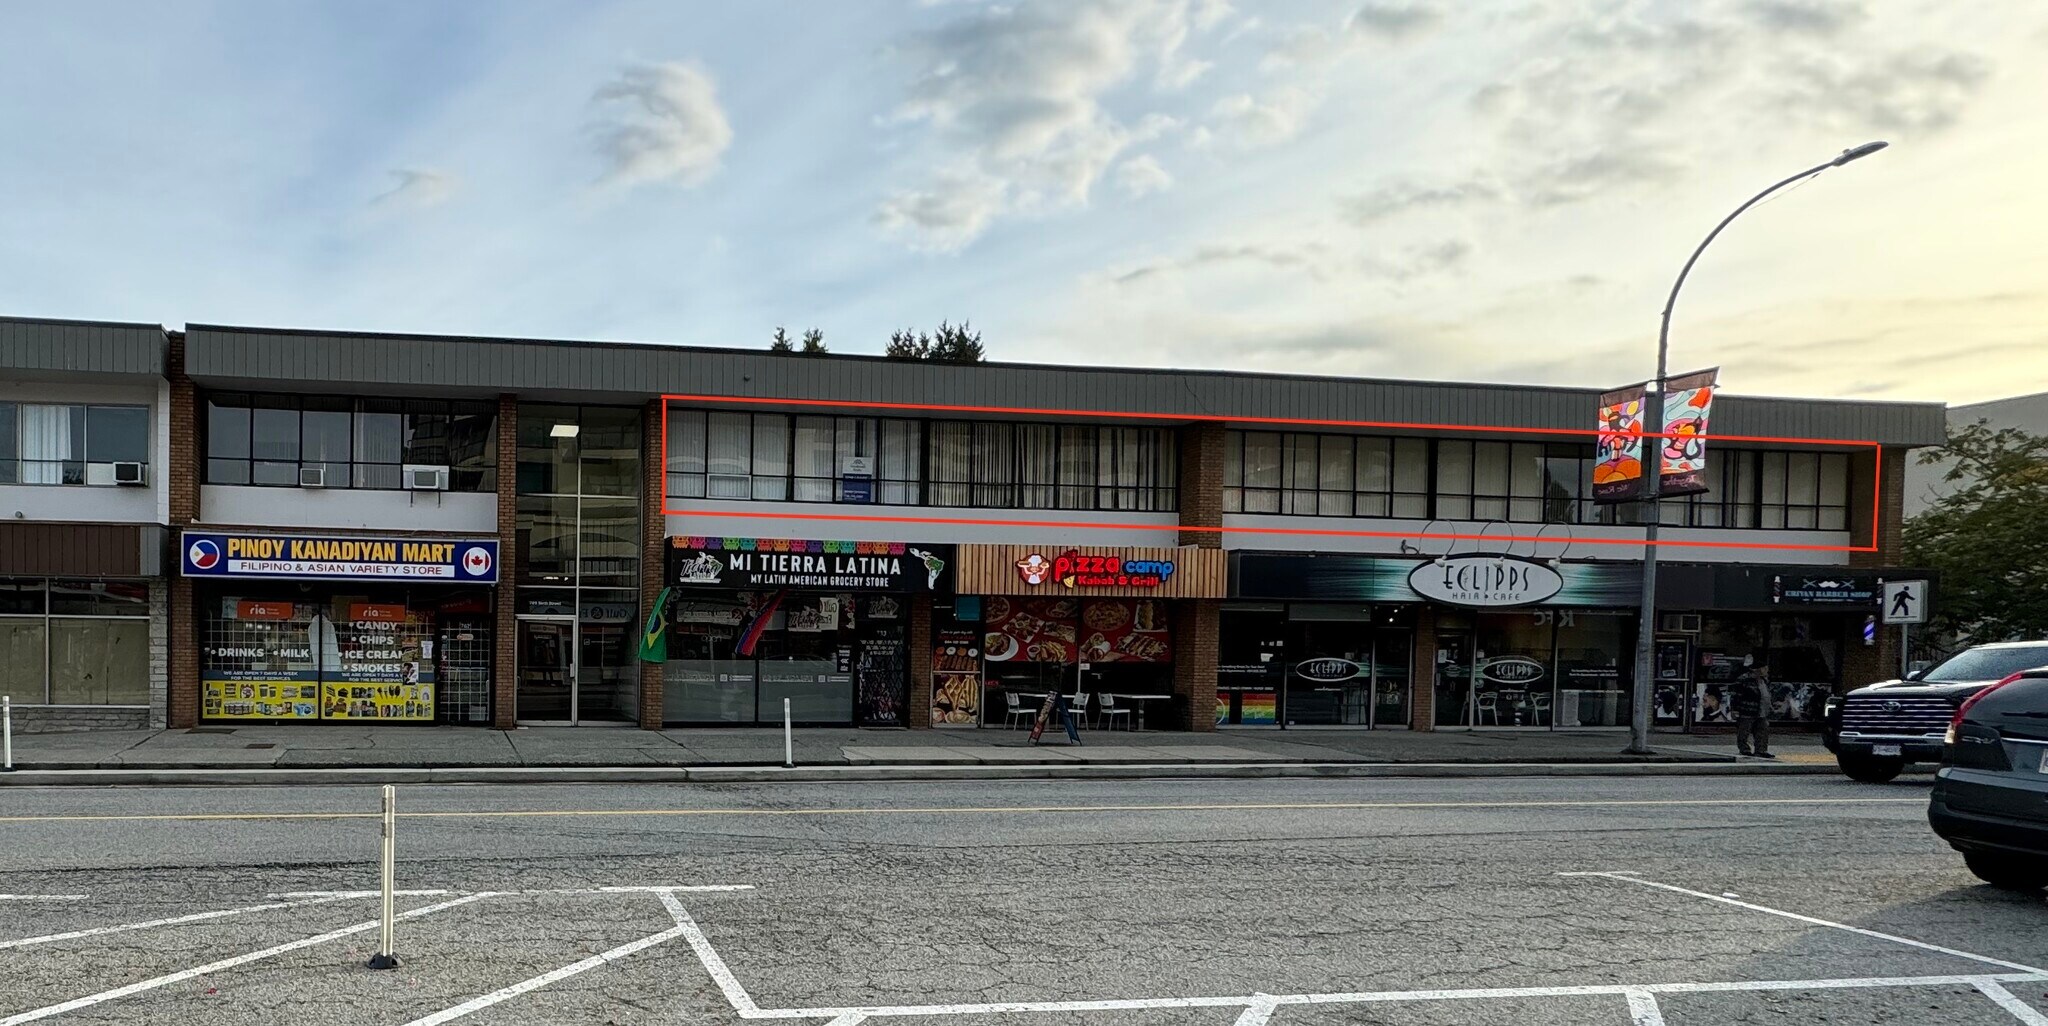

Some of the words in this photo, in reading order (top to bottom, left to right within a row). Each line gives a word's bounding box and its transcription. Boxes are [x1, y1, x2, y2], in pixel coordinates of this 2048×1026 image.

[228, 538, 286, 559] PINOY
[291, 540, 396, 562] KANADIYAN
[402, 543, 456, 563] MART
[240, 561, 292, 572] FILIPINO
[295, 562, 304, 572] &
[307, 563, 345, 573] ASIAN
[350, 564, 399, 574] VARIETY
[402, 565, 443, 575] STORE
[729, 553, 751, 571] MI
[760, 554, 827, 573] TIERRA
[835, 556, 902, 576] LATINA
[1055, 556, 1119, 582] pizza
[1125, 561, 1174, 582] camp
[750, 573, 762, 584] MY
[764, 574, 787, 585] LATIN
[788, 575, 828, 586] AMERICAN
[829, 577, 863, 587] GROCERY
[866, 577, 889, 588] STORE
[1077, 575, 1115, 586] Kabab
[1131, 576, 1160, 586] Grill
[1443, 564, 1529, 592] ECLIPPS
[1452, 592, 1480, 600] HAIR
[1493, 593, 1521, 601] CAFE
[249, 604, 266, 615] ria
[362, 606, 379, 617] ria
[355, 621, 398, 631] CANDY
[358, 635, 395, 645] CHIPS
[218, 648, 265, 657] DRINKS
[280, 648, 310, 658] MILK
[344, 650, 364, 659] ICE
[350, 663, 401, 673] SMOKES
